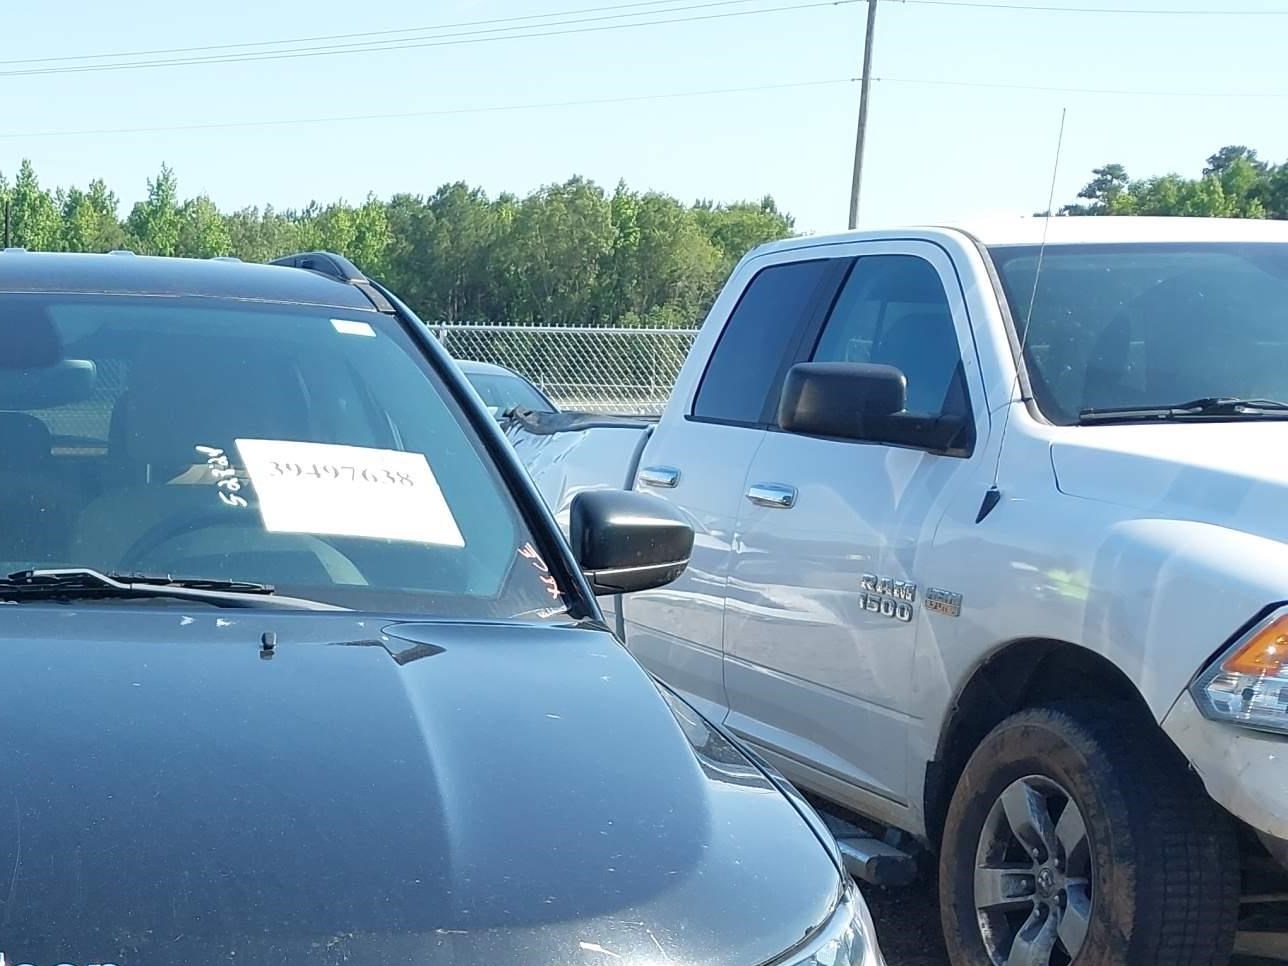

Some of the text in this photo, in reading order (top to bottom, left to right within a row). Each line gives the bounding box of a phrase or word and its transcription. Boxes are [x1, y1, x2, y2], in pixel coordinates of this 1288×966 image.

[270, 461, 416, 487] 39497638
[862, 573, 917, 601] RAM
[859, 591, 914, 622] 1500
